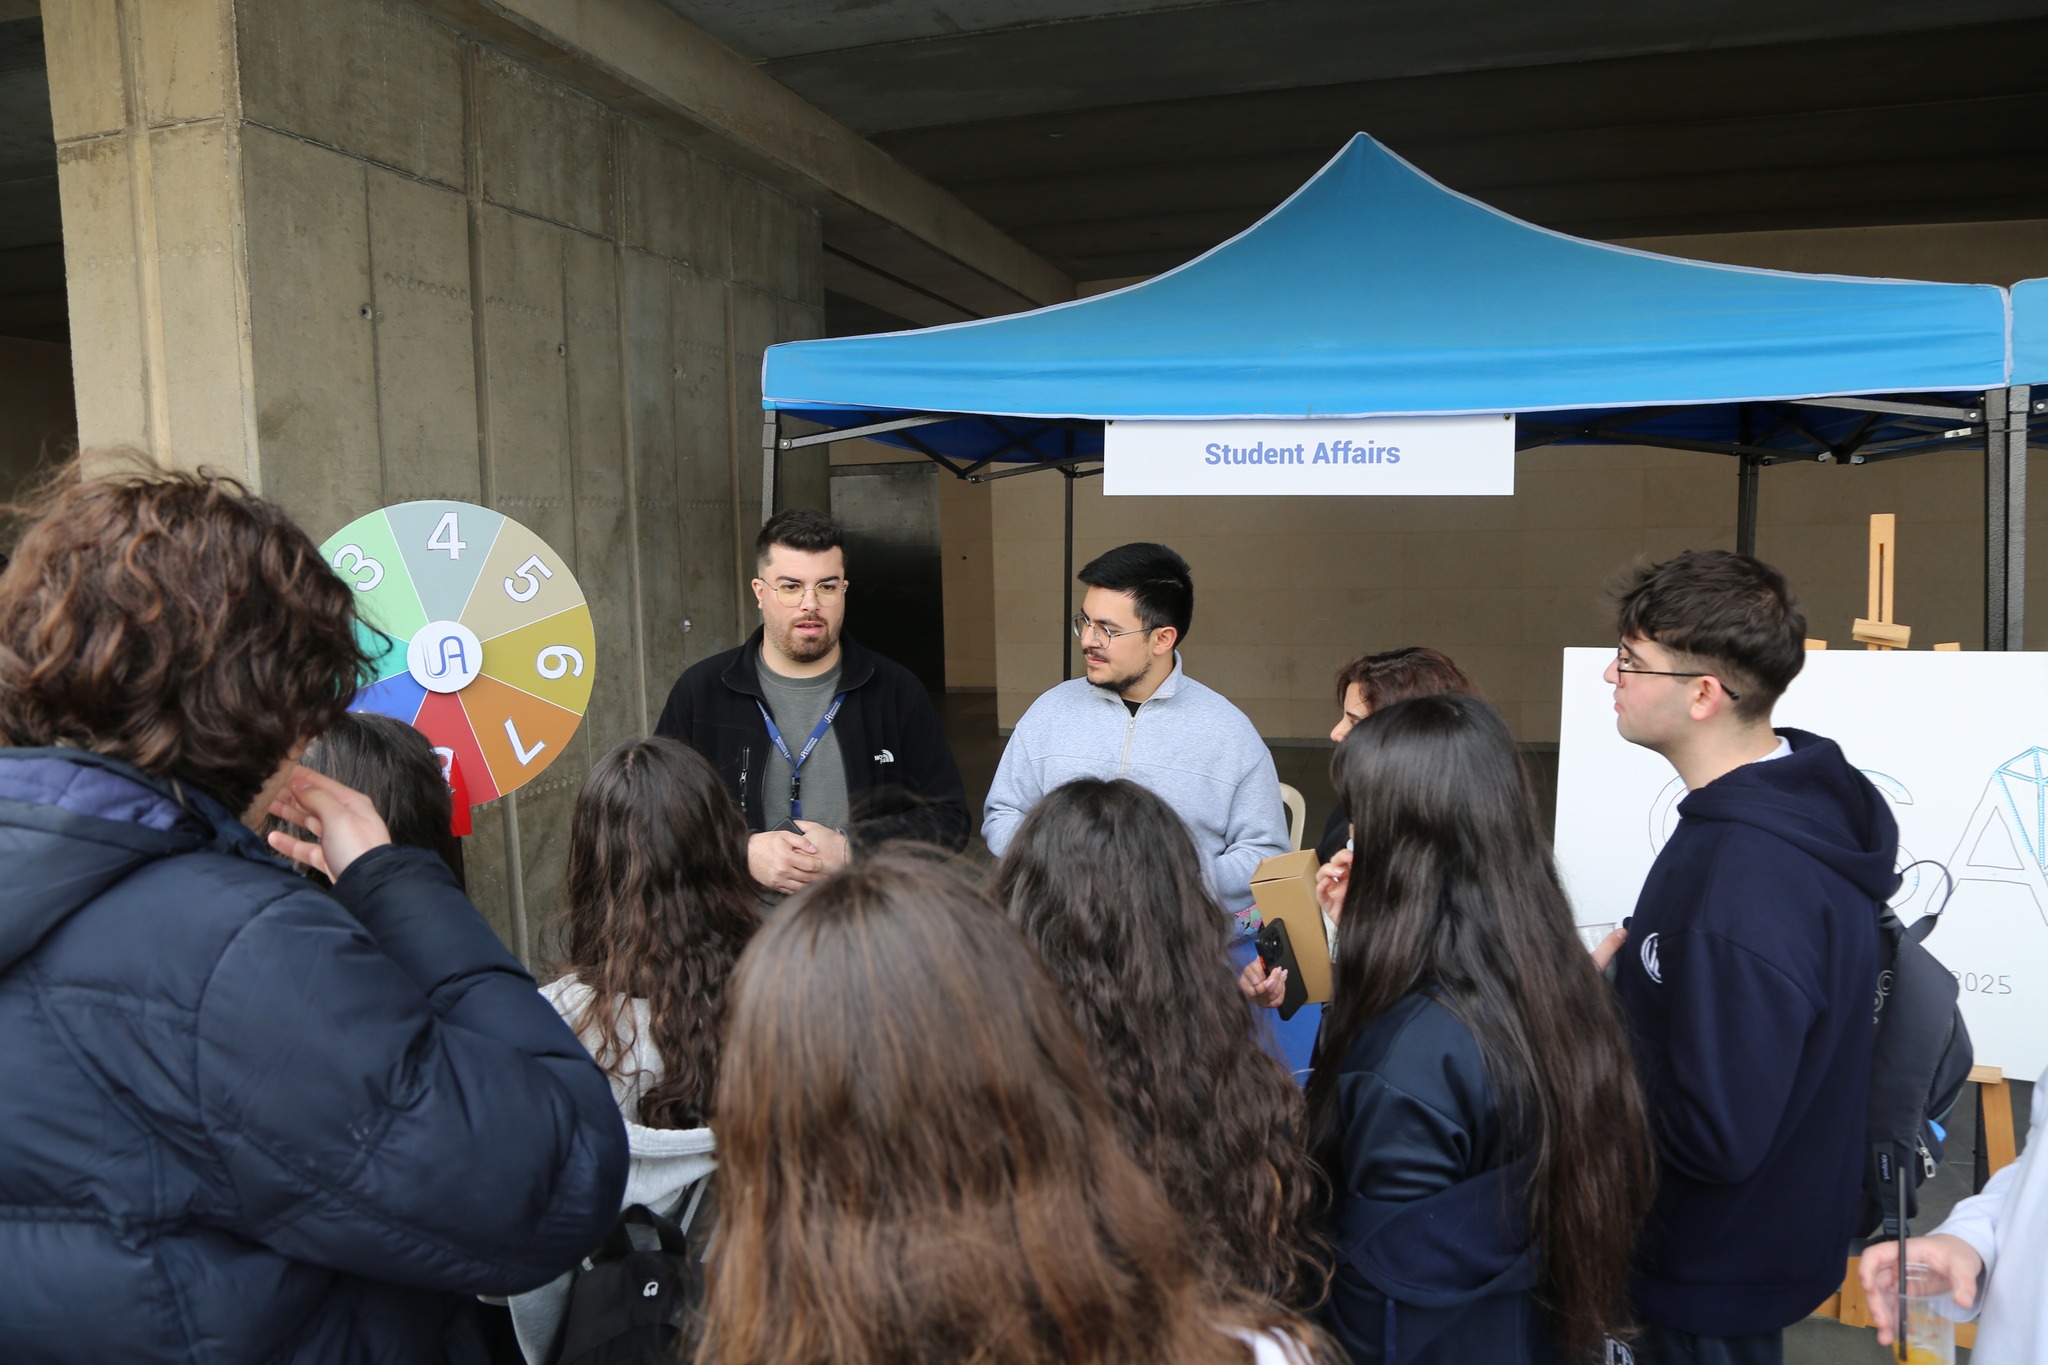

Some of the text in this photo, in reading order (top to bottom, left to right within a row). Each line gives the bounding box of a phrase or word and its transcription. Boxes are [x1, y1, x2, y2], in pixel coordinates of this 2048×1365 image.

[1205, 440, 1401, 464] Student Affairs
[427, 512, 467, 561] 4
[332, 543, 385, 592] 3
[503, 554, 553, 603] 5
[535, 645, 585, 680] 6
[503, 717, 547, 767] 7
